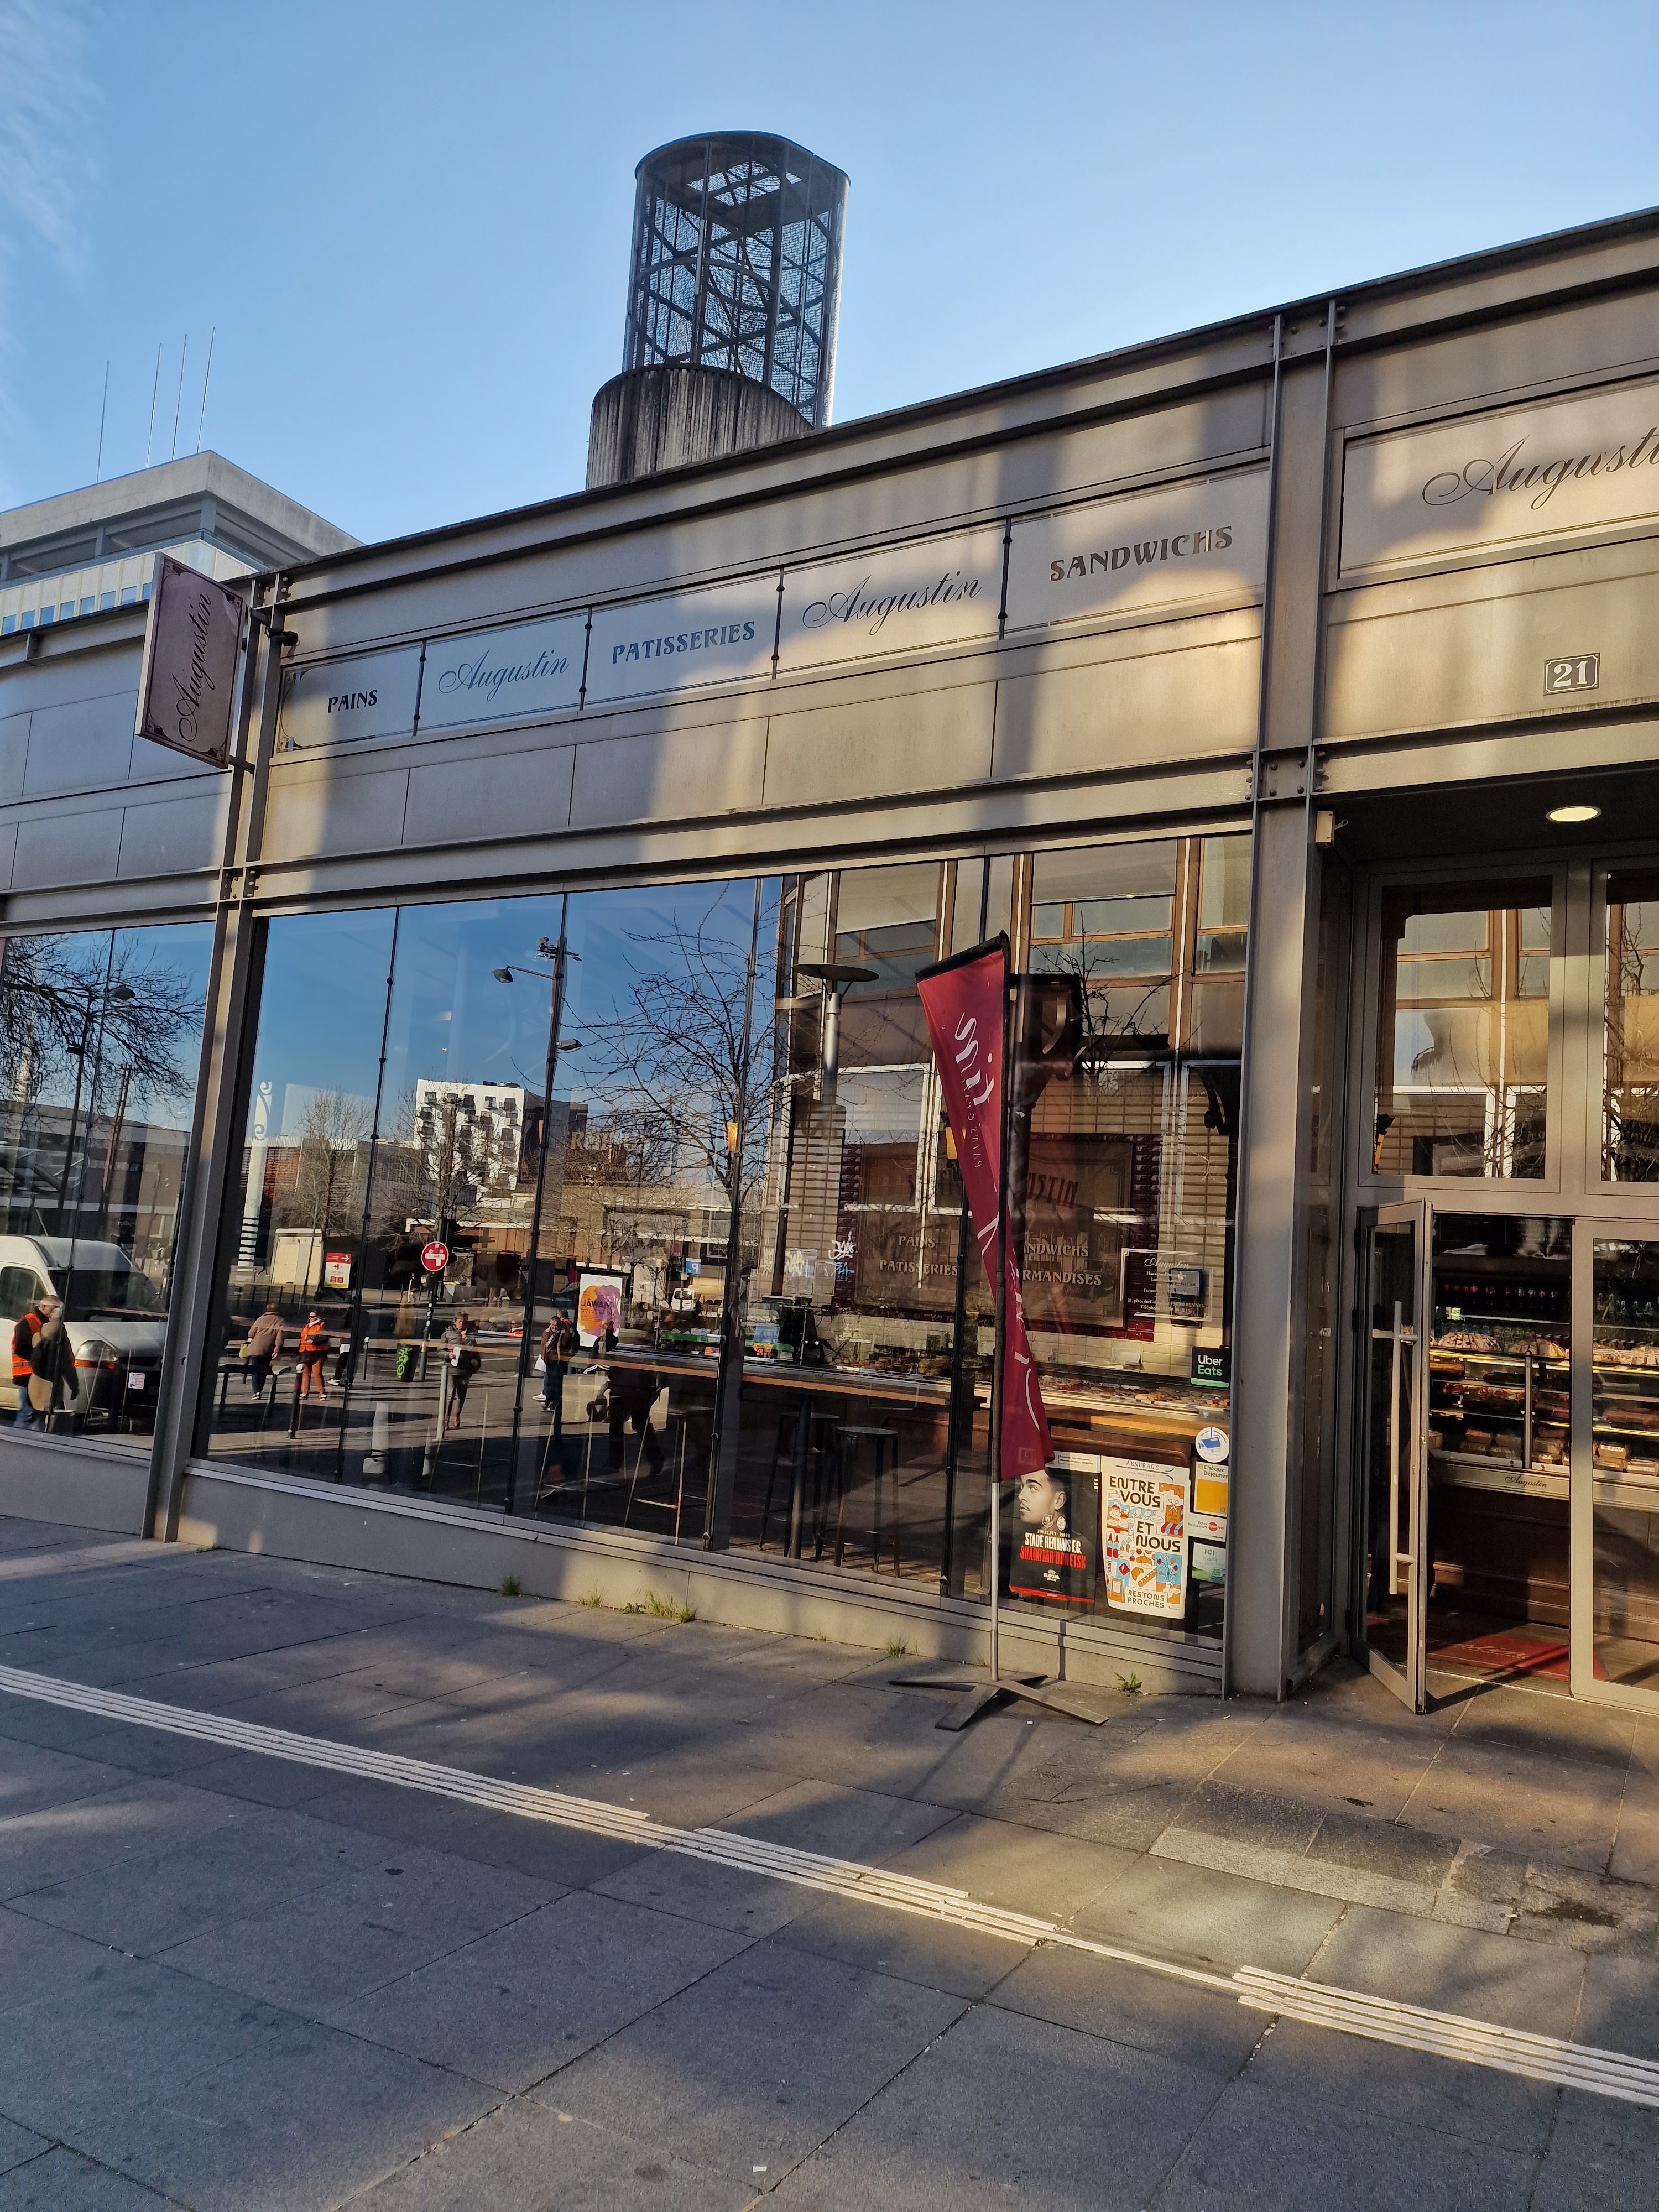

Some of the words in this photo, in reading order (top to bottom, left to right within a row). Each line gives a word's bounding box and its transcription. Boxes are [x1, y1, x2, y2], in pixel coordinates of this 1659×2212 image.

[1422, 427, 1659, 510] Augusti
[1050, 525, 1233, 582] SANDWICHS
[802, 571, 982, 636] Augustin
[612, 620, 756, 664] PATISSERIES
[172, 593, 215, 742] Augustin
[439, 650, 570, 702] Augustin
[1553, 659, 1589, 688] 21
[327, 689, 378, 713] PAINS
[1144, 1256, 1189, 1271] Augustin
[1023, 1270, 1102, 1286] RMANDISES
[1198, 1354, 1223, 1366] Uber
[1198, 1365, 1223, 1376] Eats
[1126, 1460, 1159, 1470] AENCRAGE
[1203, 1470, 1228, 1479] Déjeuner
[1504, 1475, 1547, 1488] Augustin
[1109, 1475, 1155, 1494] ENTRE
[1120, 1490, 1161, 1509] VOUS
[1136, 1521, 1154, 1535] ET
[1025, 1532, 1044, 1548] STADE
[1044, 1536, 1071, 1552] RENNAIS
[1136, 1534, 1181, 1552] NOUS
[1128, 1590, 1165, 1601] RESTONS
[1128, 1597, 1165, 1609] PROCHES
